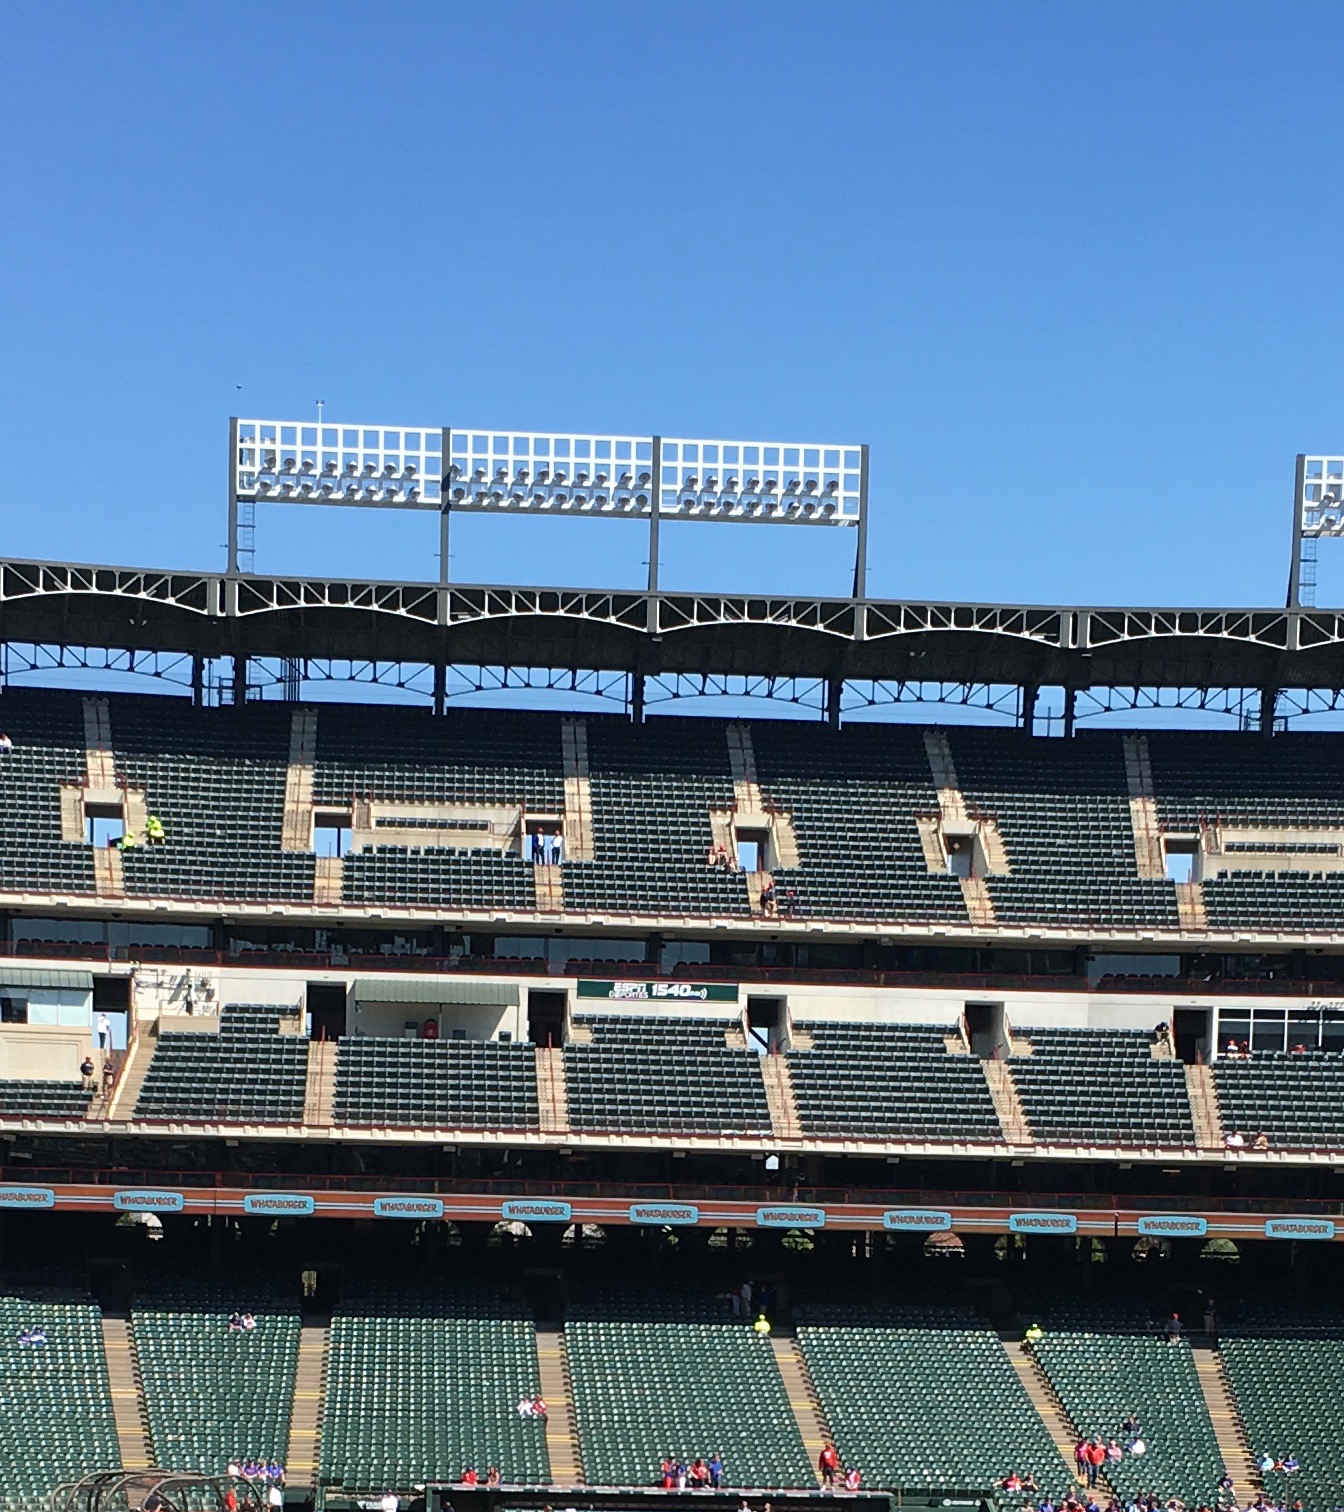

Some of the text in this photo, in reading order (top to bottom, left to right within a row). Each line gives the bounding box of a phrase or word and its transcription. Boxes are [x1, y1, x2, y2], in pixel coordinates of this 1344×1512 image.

[613, 983, 647, 992] ESPN
[652, 983, 691, 997] 1540
[120, 1195, 177, 1206] WHATABURGER
[250, 1199, 308, 1210] WHATABURGER
[379, 1202, 437, 1213] WHATABURGER
[508, 1205, 565, 1216] WHATABURGER
[635, 1208, 692, 1219] WHATABURGER
[763, 1212, 819, 1223] WHATABURGER
[889, 1215, 945, 1226] WHATABURGER
[1014, 1217, 1071, 1228] WHATABURGER
[1144, 1221, 1201, 1231] WHATABURGER
[1271, 1223, 1328, 1234] WHATABURGER
